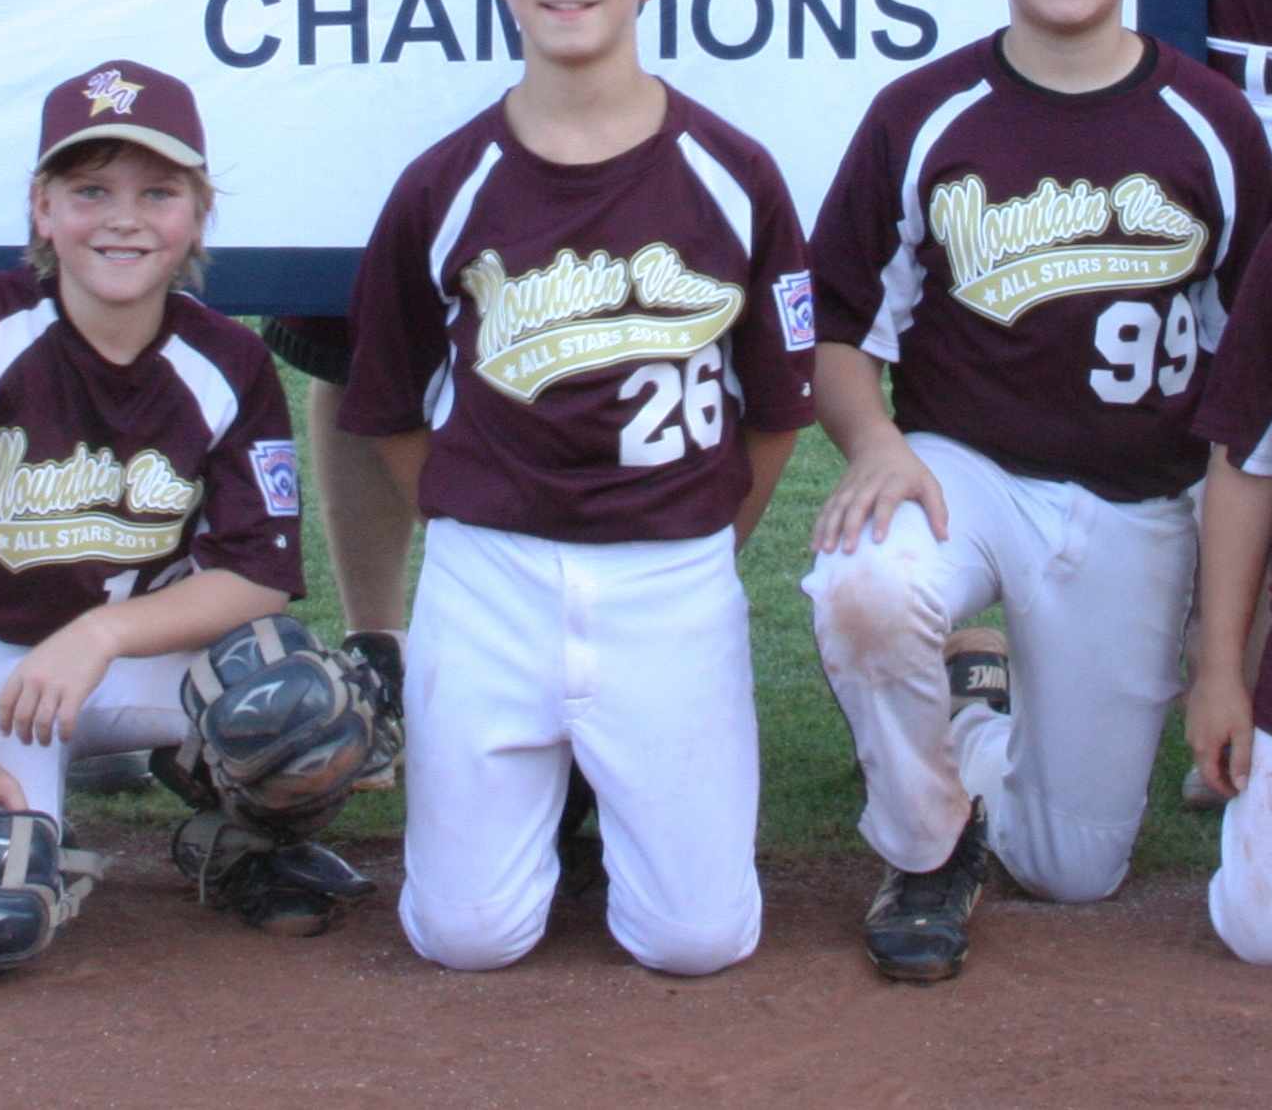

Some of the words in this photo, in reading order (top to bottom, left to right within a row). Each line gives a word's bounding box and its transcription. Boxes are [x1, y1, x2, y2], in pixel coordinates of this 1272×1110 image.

[931, 178, 1107, 285] Mountain
[1114, 177, 1196, 237] View
[1000, 272, 1036, 301] ALL
[1040, 258, 1102, 283] STARS
[1107, 256, 1150, 274] 2011
[462, 252, 629, 358] Mountain
[632, 245, 725, 310] View
[520, 346, 556, 370] ALL
[560, 330, 623, 356] STARS
[627, 327, 671, 346] 2011
[1089, 292, 1197, 404] 99
[618, 343, 724, 467] 26
[14, 530, 49, 552] ALL
[56, 525, 111, 547] STARS
[116, 532, 157, 548] 2011
